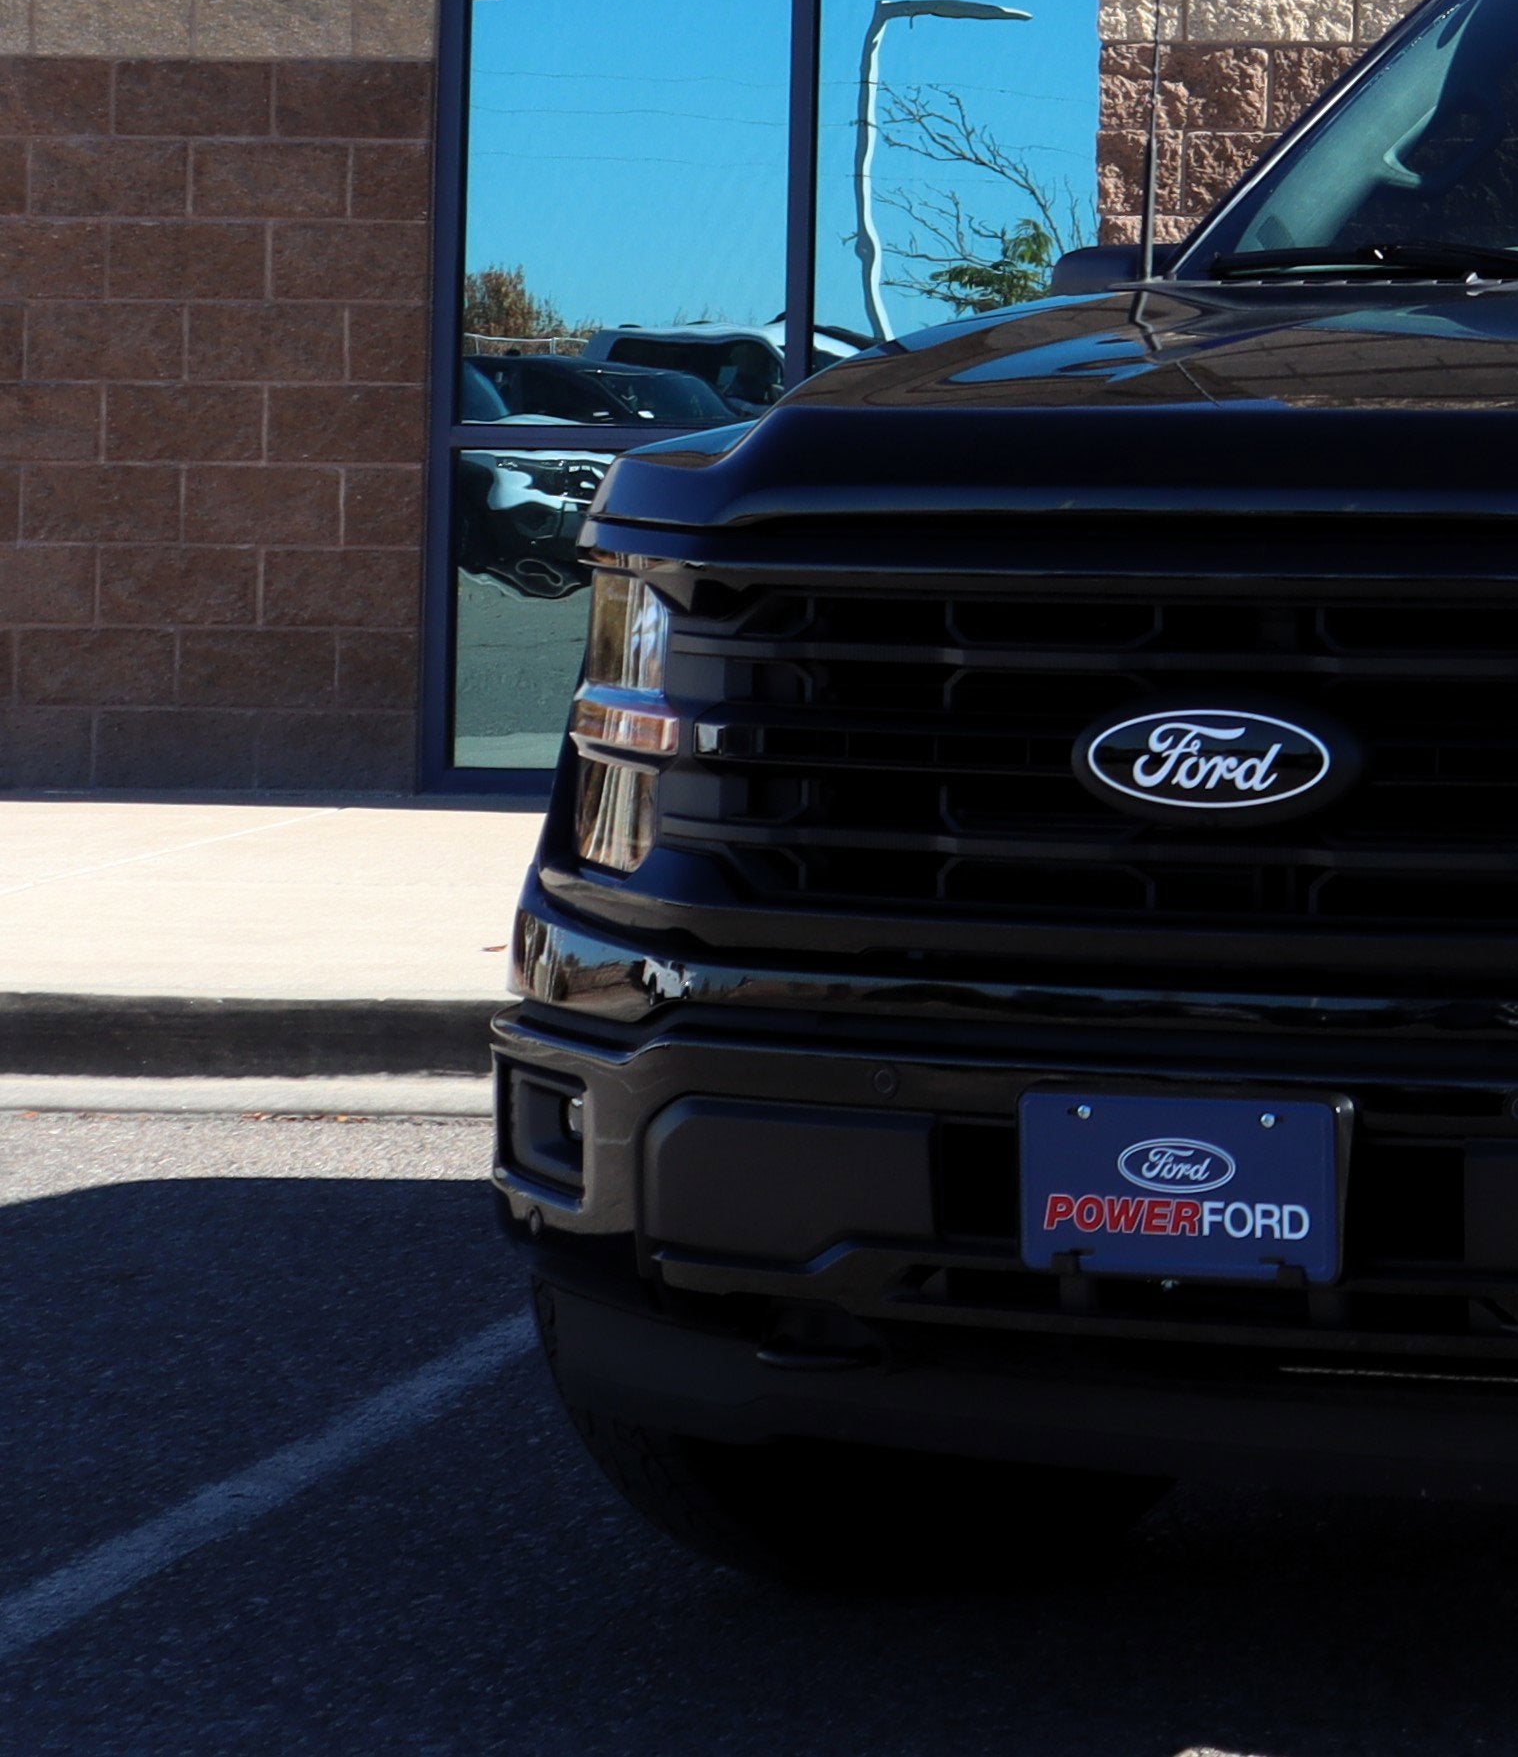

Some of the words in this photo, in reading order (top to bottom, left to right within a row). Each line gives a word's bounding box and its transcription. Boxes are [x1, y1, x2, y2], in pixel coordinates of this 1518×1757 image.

[1132, 721, 1283, 792] Ford
[1141, 1147, 1212, 1182] Ford
[1043, 1193, 1310, 1241] POWERFORD
